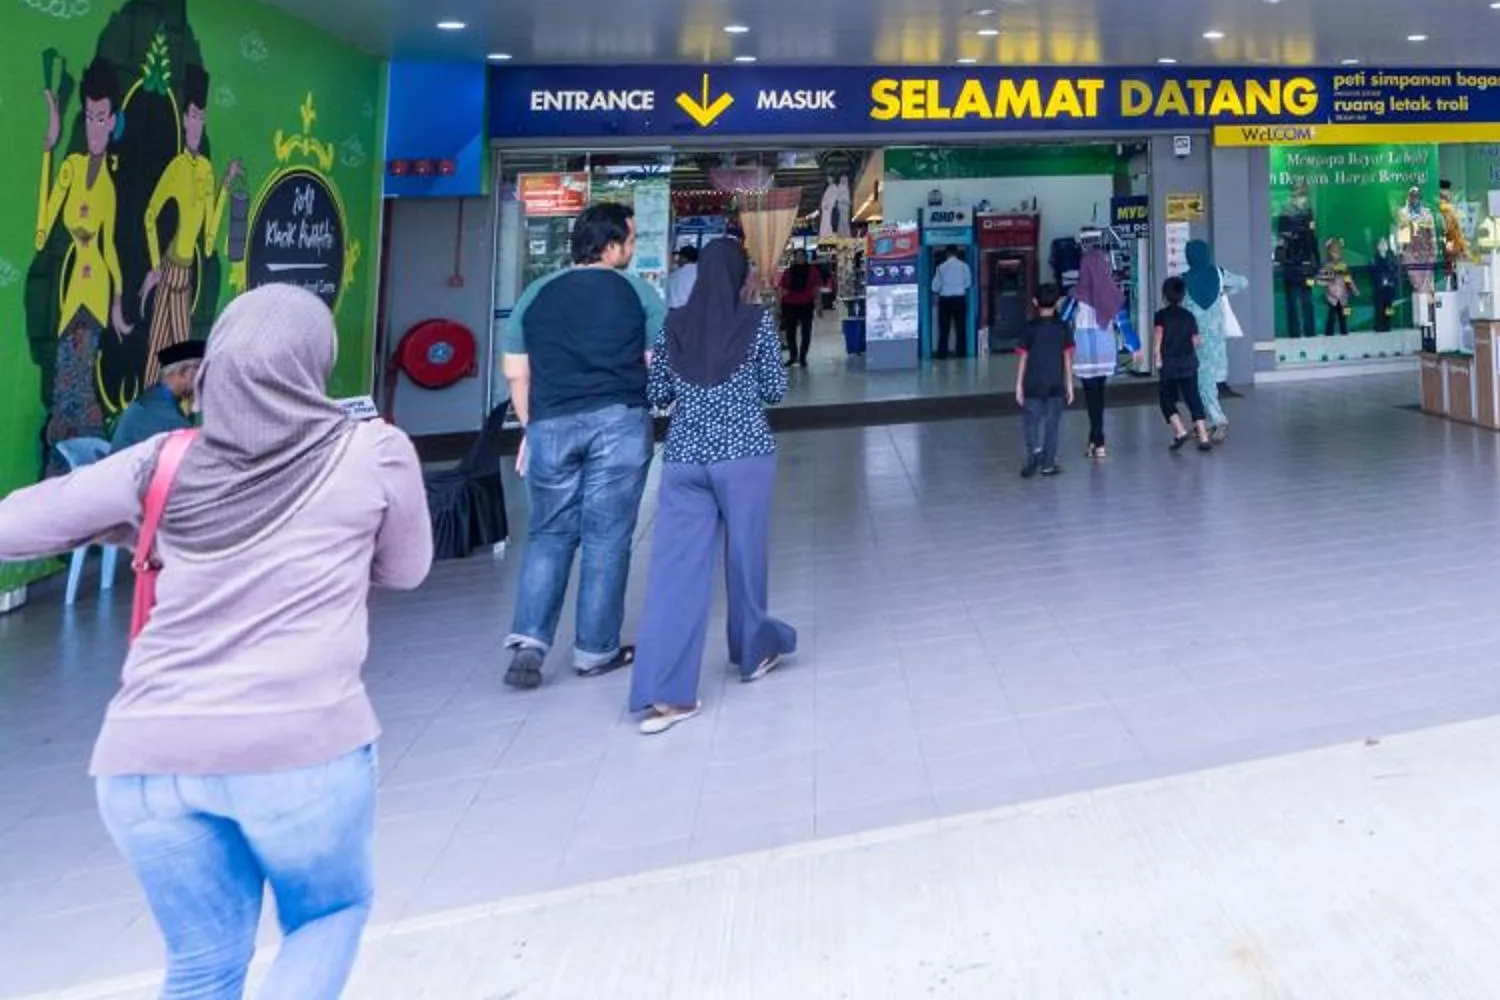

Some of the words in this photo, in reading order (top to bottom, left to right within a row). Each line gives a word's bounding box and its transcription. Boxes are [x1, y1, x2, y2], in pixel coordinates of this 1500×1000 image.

[1333, 72, 1365, 90] peti
[1370, 72, 1451, 90] simpanan
[530, 90, 655, 111] ENTRANCE
[756, 89, 837, 109] MASUK
[869, 78, 1105, 119] SELAMAT
[1120, 77, 1319, 117] DATANG
[1333, 99, 1385, 115] ruang
[1389, 96, 1432, 111] letak
[1436, 96, 1470, 111] troli
